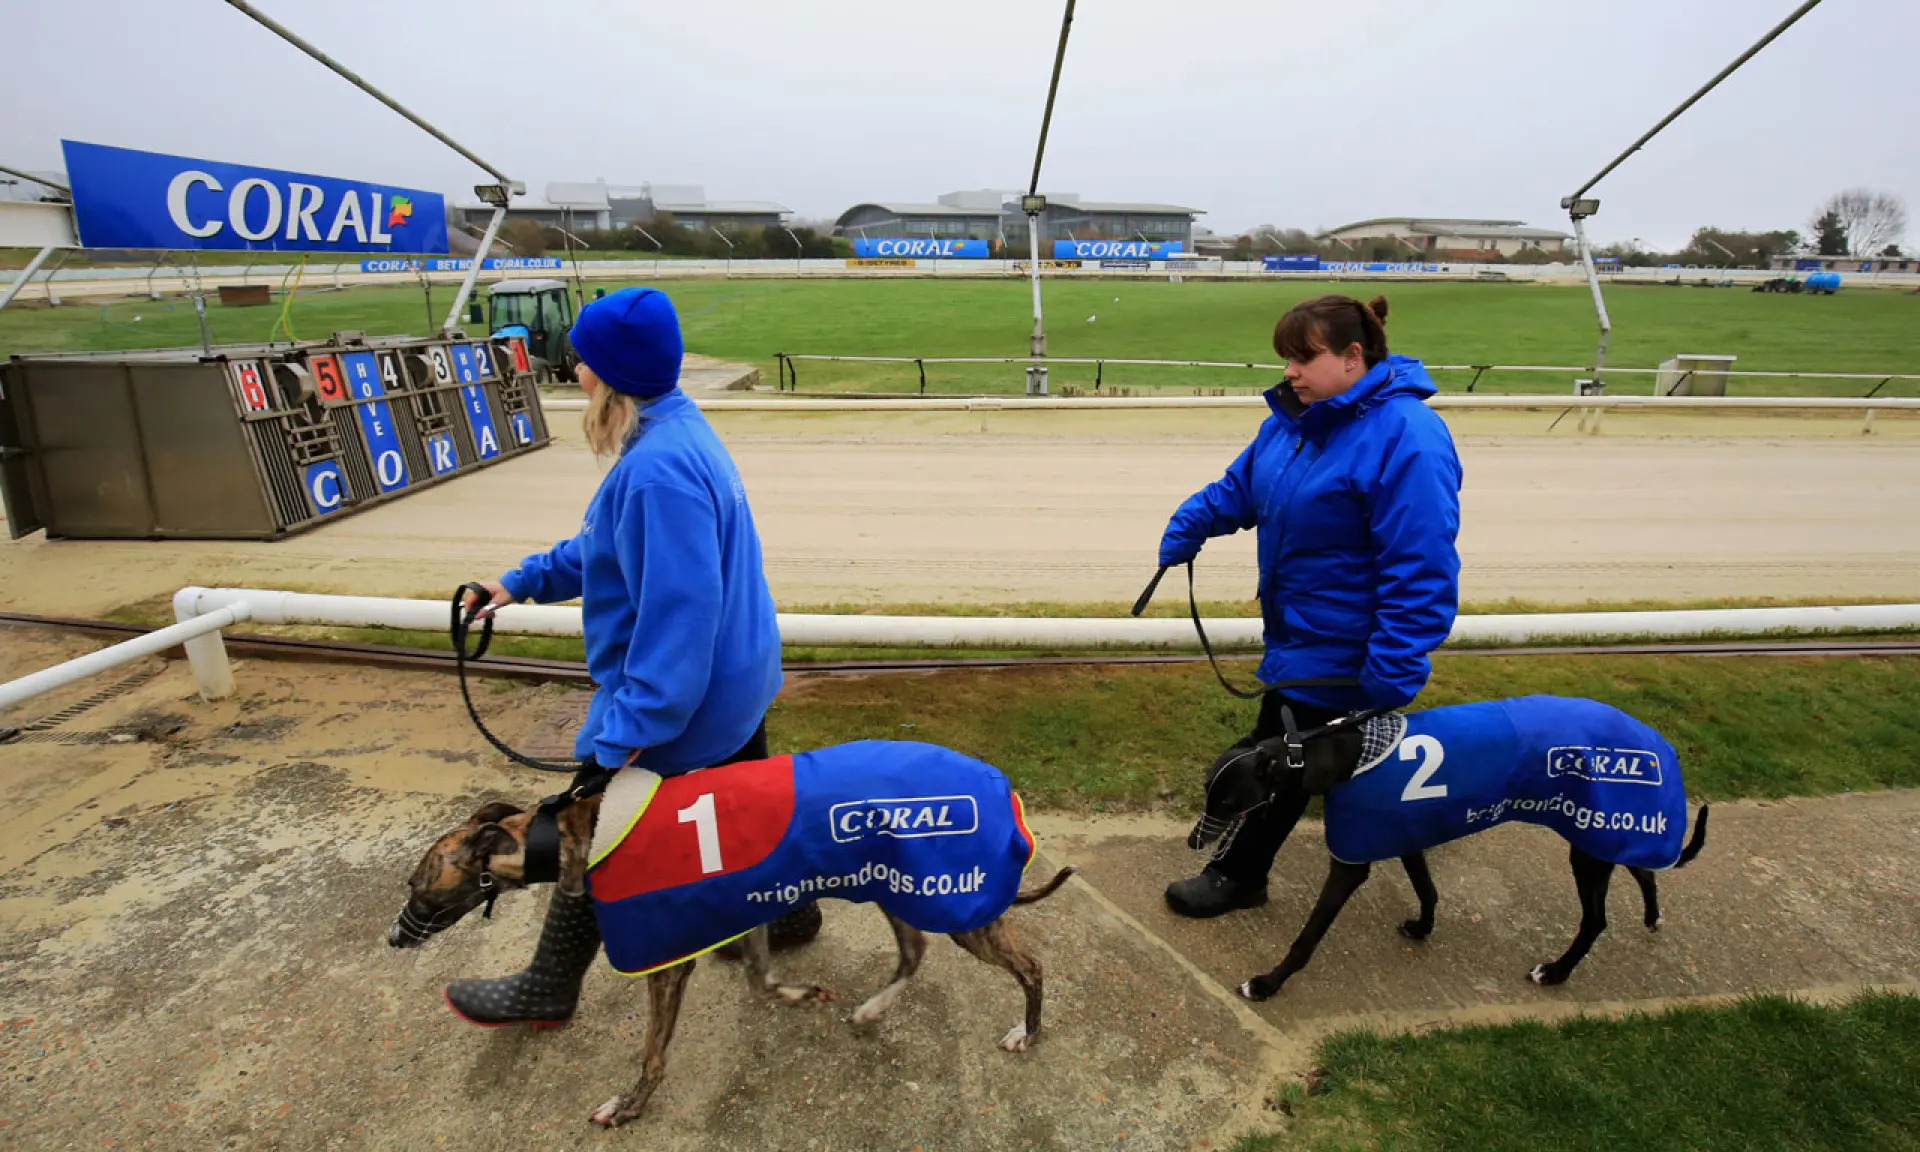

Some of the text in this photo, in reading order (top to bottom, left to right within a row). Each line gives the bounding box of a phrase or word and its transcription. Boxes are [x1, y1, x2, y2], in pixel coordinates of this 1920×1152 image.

[167, 170, 392, 244] CORAL
[877, 240, 954, 256] CORAL
[1076, 242, 1152, 257] CORAL
[367, 260, 420, 272] CORAL
[437, 260, 456, 271] BET
[458, 260, 473, 270] NO
[383, 355, 399, 388] 4
[433, 351, 448, 380] 3
[476, 347, 490, 375] 2
[240, 368, 266, 409] 6
[315, 361, 337, 396] 5
[1399, 734, 1447, 801] 2
[1555, 753, 1643, 775] CORAL
[677, 792, 723, 874] 1
[840, 805, 953, 833] CORAL
